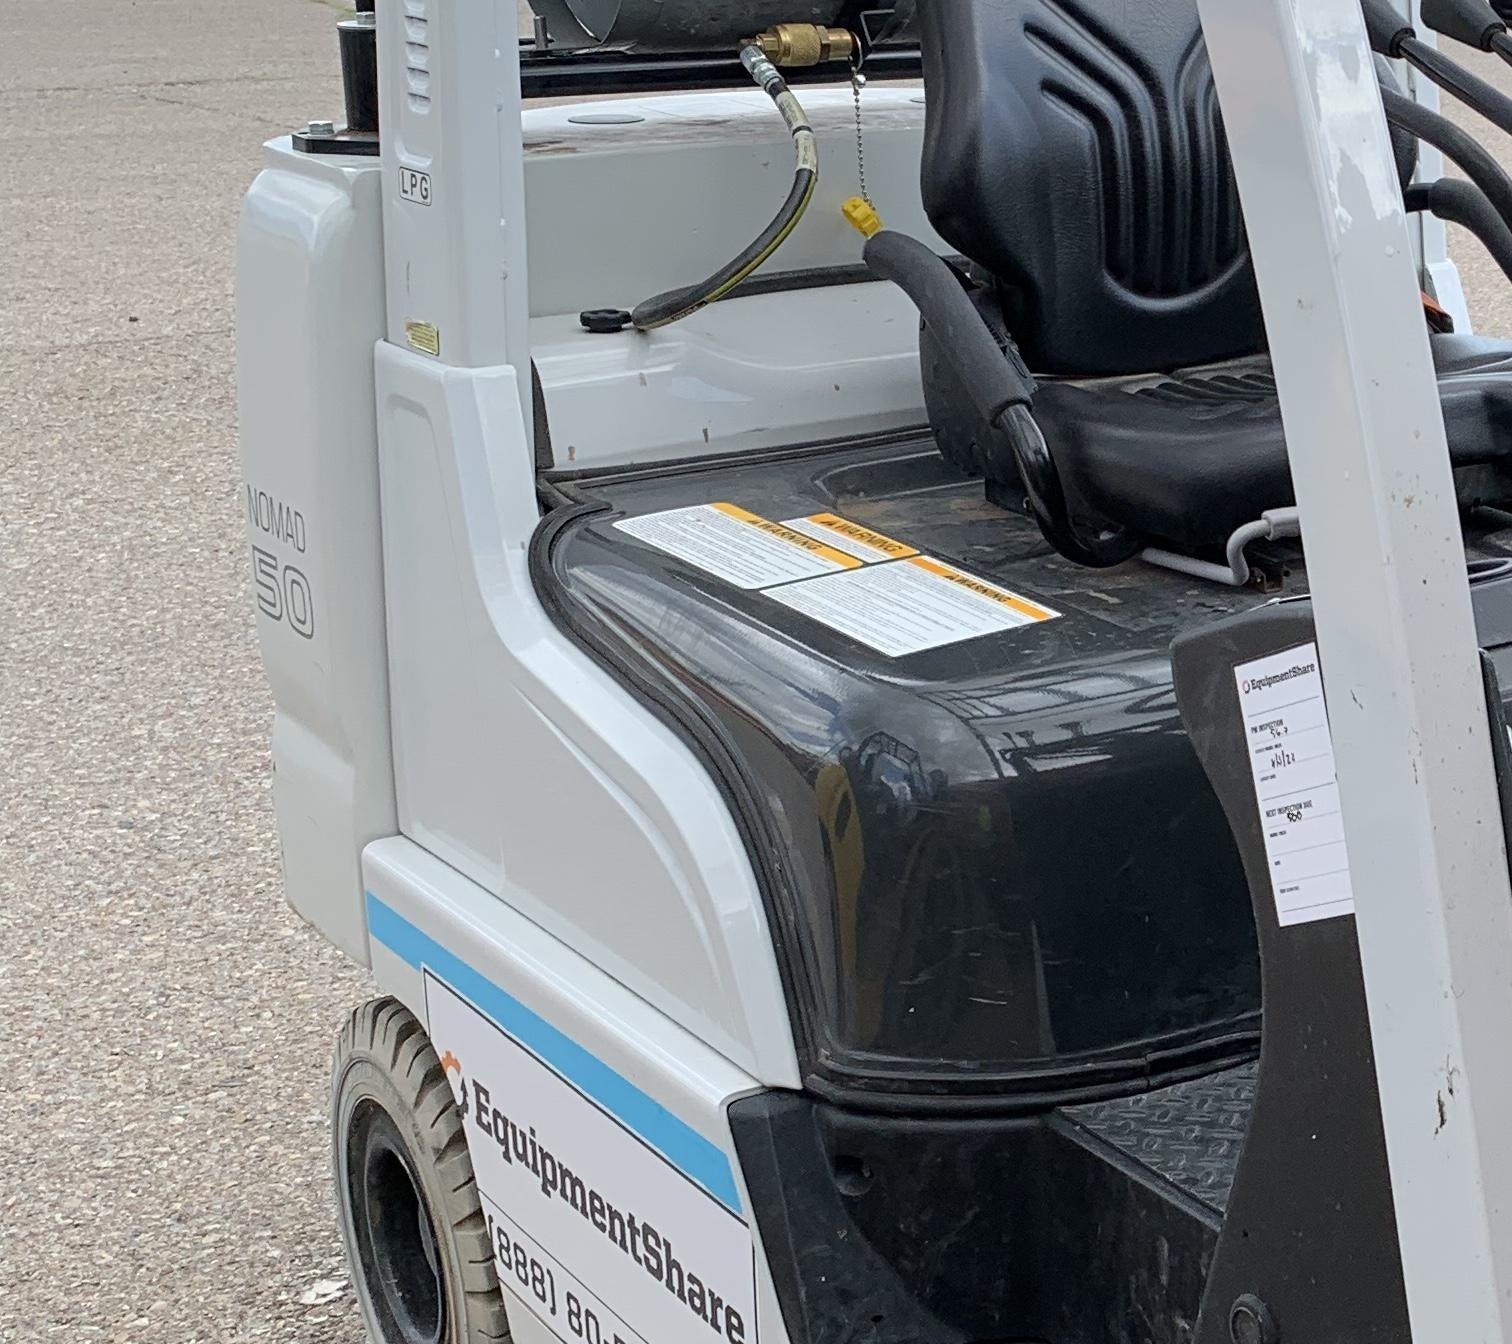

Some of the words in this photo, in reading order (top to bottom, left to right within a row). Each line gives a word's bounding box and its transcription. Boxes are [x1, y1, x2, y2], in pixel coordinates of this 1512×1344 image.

[401, 170, 429, 200] LPG
[247, 484, 306, 554] NOMAD
[758, 519, 823, 551] WARNING
[252, 544, 314, 640] 50
[1251, 663, 1316, 691] EquipmentShare
